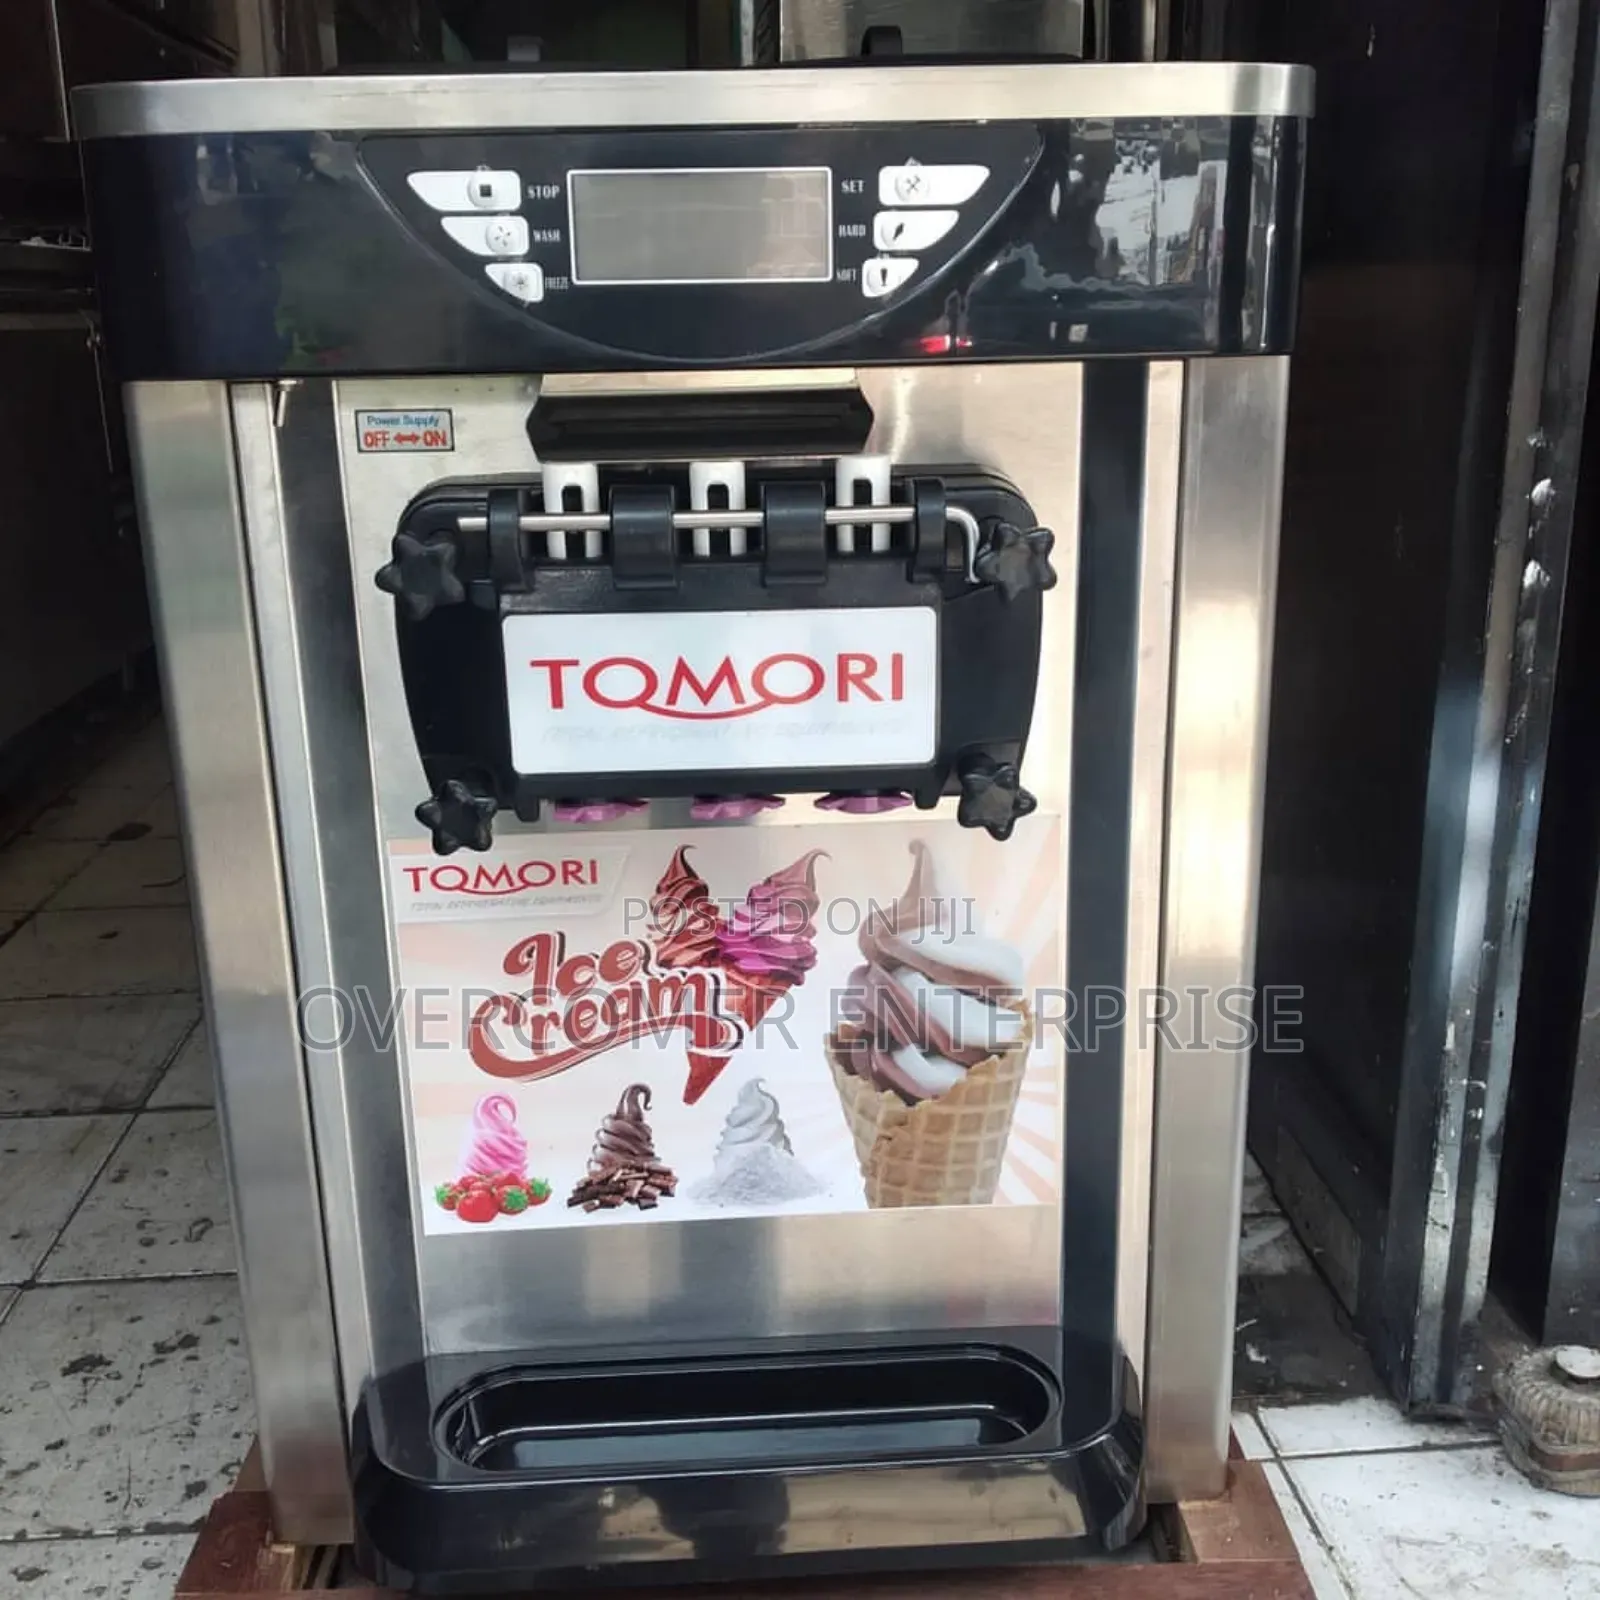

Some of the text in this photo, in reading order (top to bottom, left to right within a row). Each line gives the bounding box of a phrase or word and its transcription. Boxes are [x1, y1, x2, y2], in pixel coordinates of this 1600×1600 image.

[527, 184, 560, 199] STOP
[841, 179, 864, 193] SET
[533, 229, 561, 242] WASH
[367, 414, 440, 427] Power Supply
[363, 430, 447, 447] OFF ON
[530, 652, 903, 720] TOMORI
[403, 859, 599, 896] TOMORI
[503, 931, 652, 1006] Ice
[468, 968, 744, 1080] Cream
